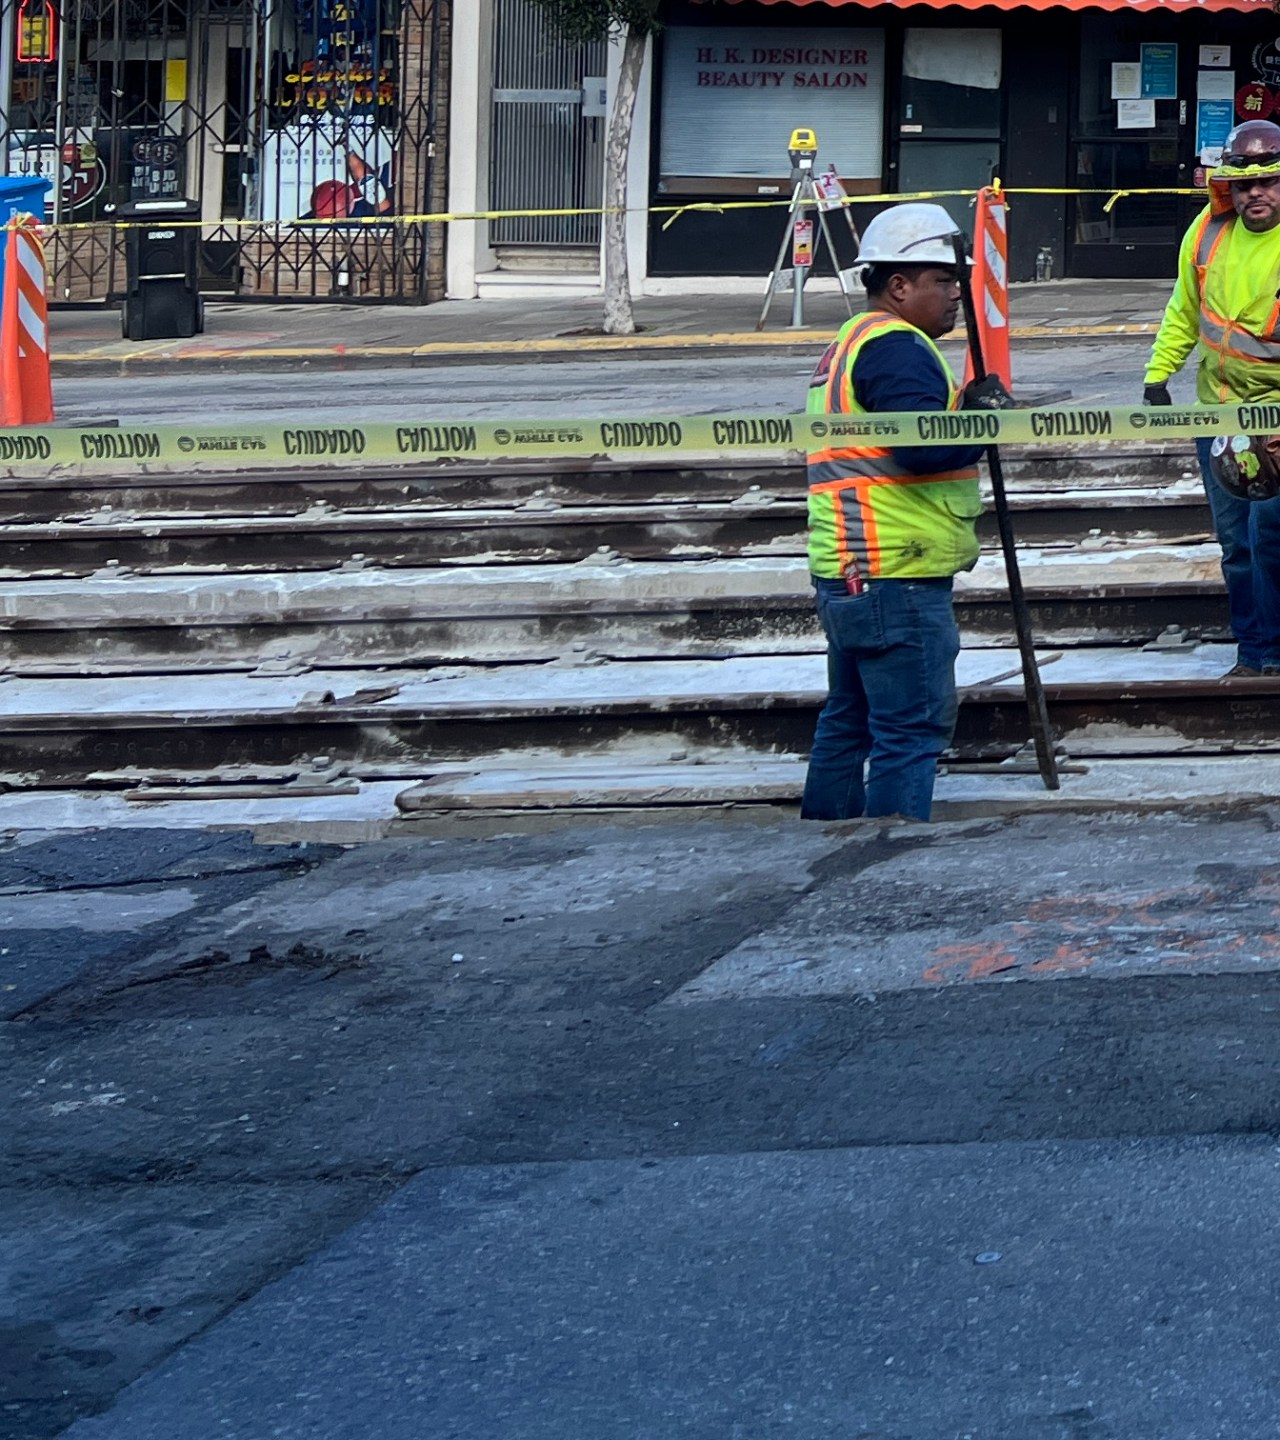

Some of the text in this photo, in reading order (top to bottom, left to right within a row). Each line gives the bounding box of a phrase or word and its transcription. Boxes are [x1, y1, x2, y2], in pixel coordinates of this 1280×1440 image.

[696, 48, 869, 65] H. K. DESIGNER
[697, 71, 868, 88] BEAUTY SALON
